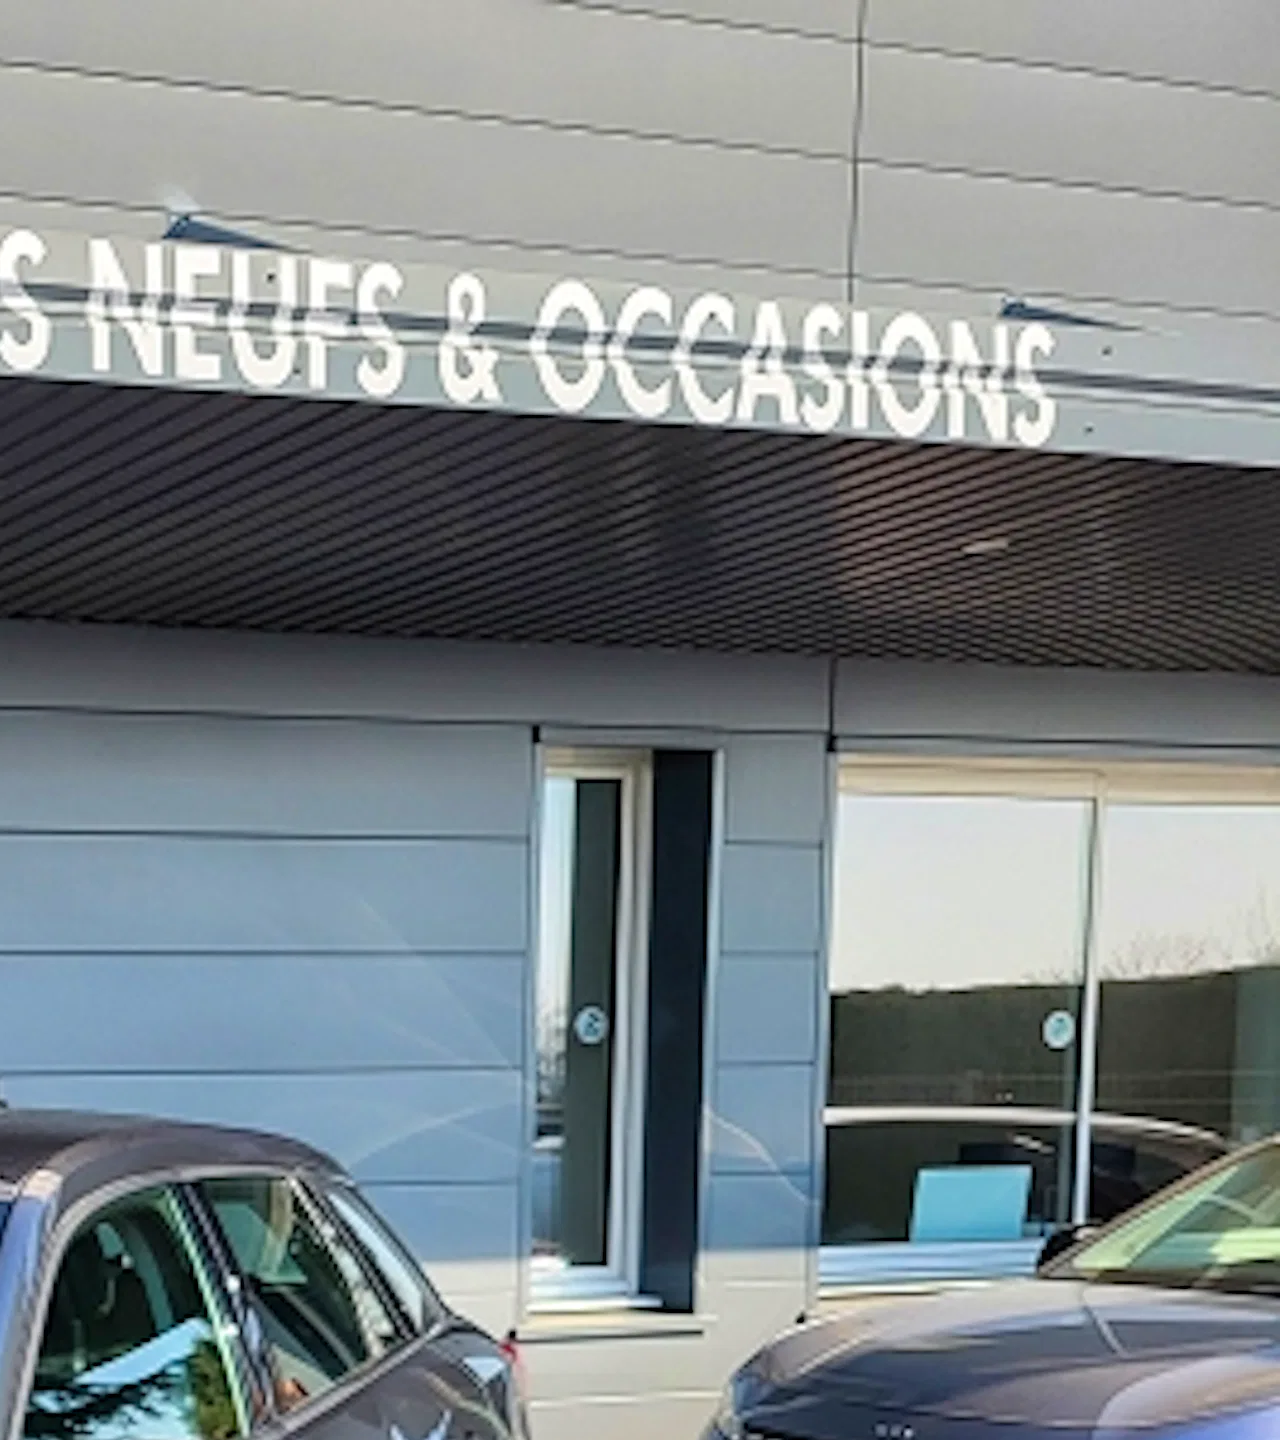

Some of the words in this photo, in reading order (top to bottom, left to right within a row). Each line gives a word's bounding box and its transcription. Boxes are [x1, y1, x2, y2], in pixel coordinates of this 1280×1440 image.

[87, 236, 407, 402] NEUFS
[440, 273, 507, 404] &
[528, 281, 1059, 449] OCCASIONS
